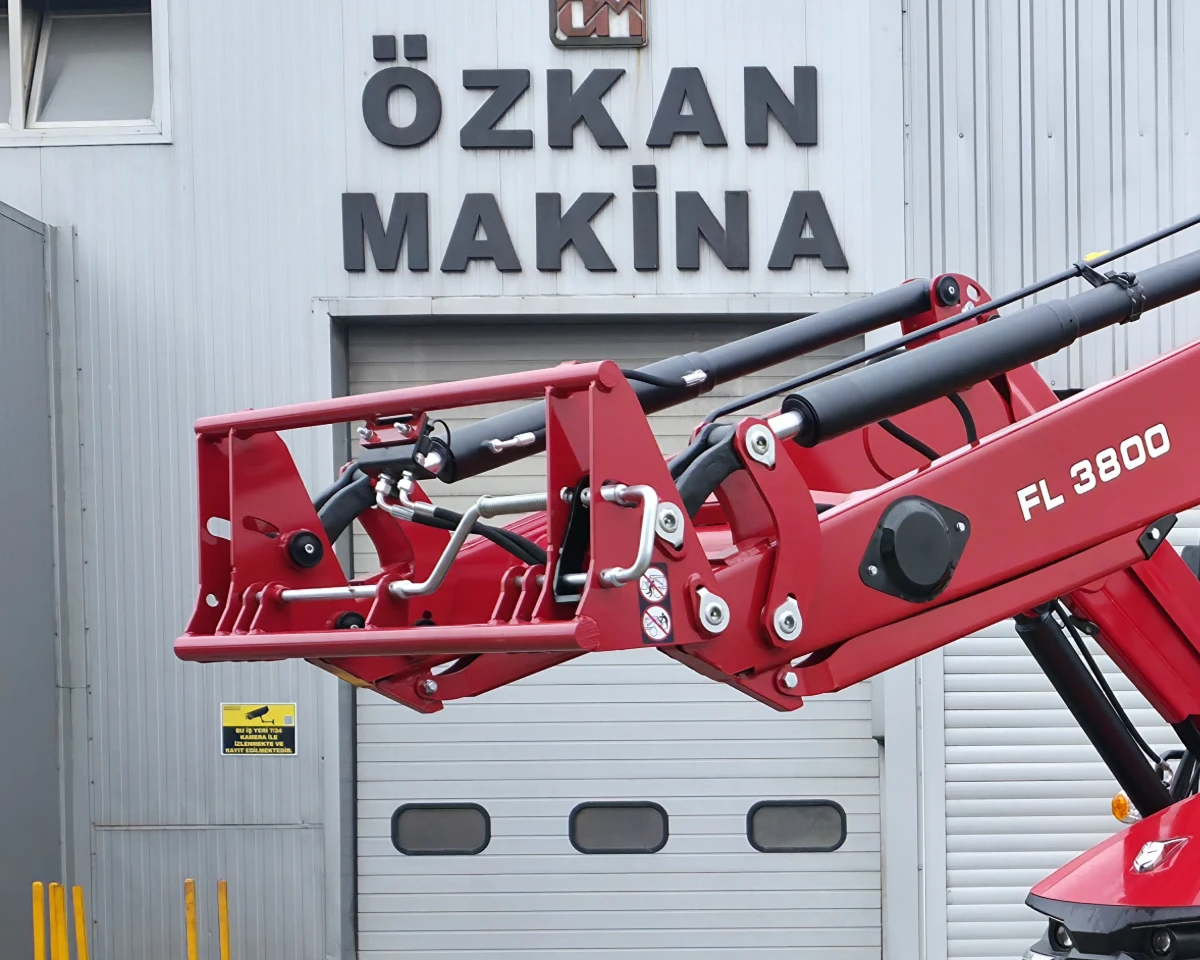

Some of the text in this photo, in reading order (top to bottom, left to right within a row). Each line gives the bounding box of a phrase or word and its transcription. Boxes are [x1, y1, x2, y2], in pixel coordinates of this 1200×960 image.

[362, 34, 818, 149] ÖZKAN
[342, 164, 849, 272] MAKİNA
[1016, 423, 1171, 522] FL 3800
